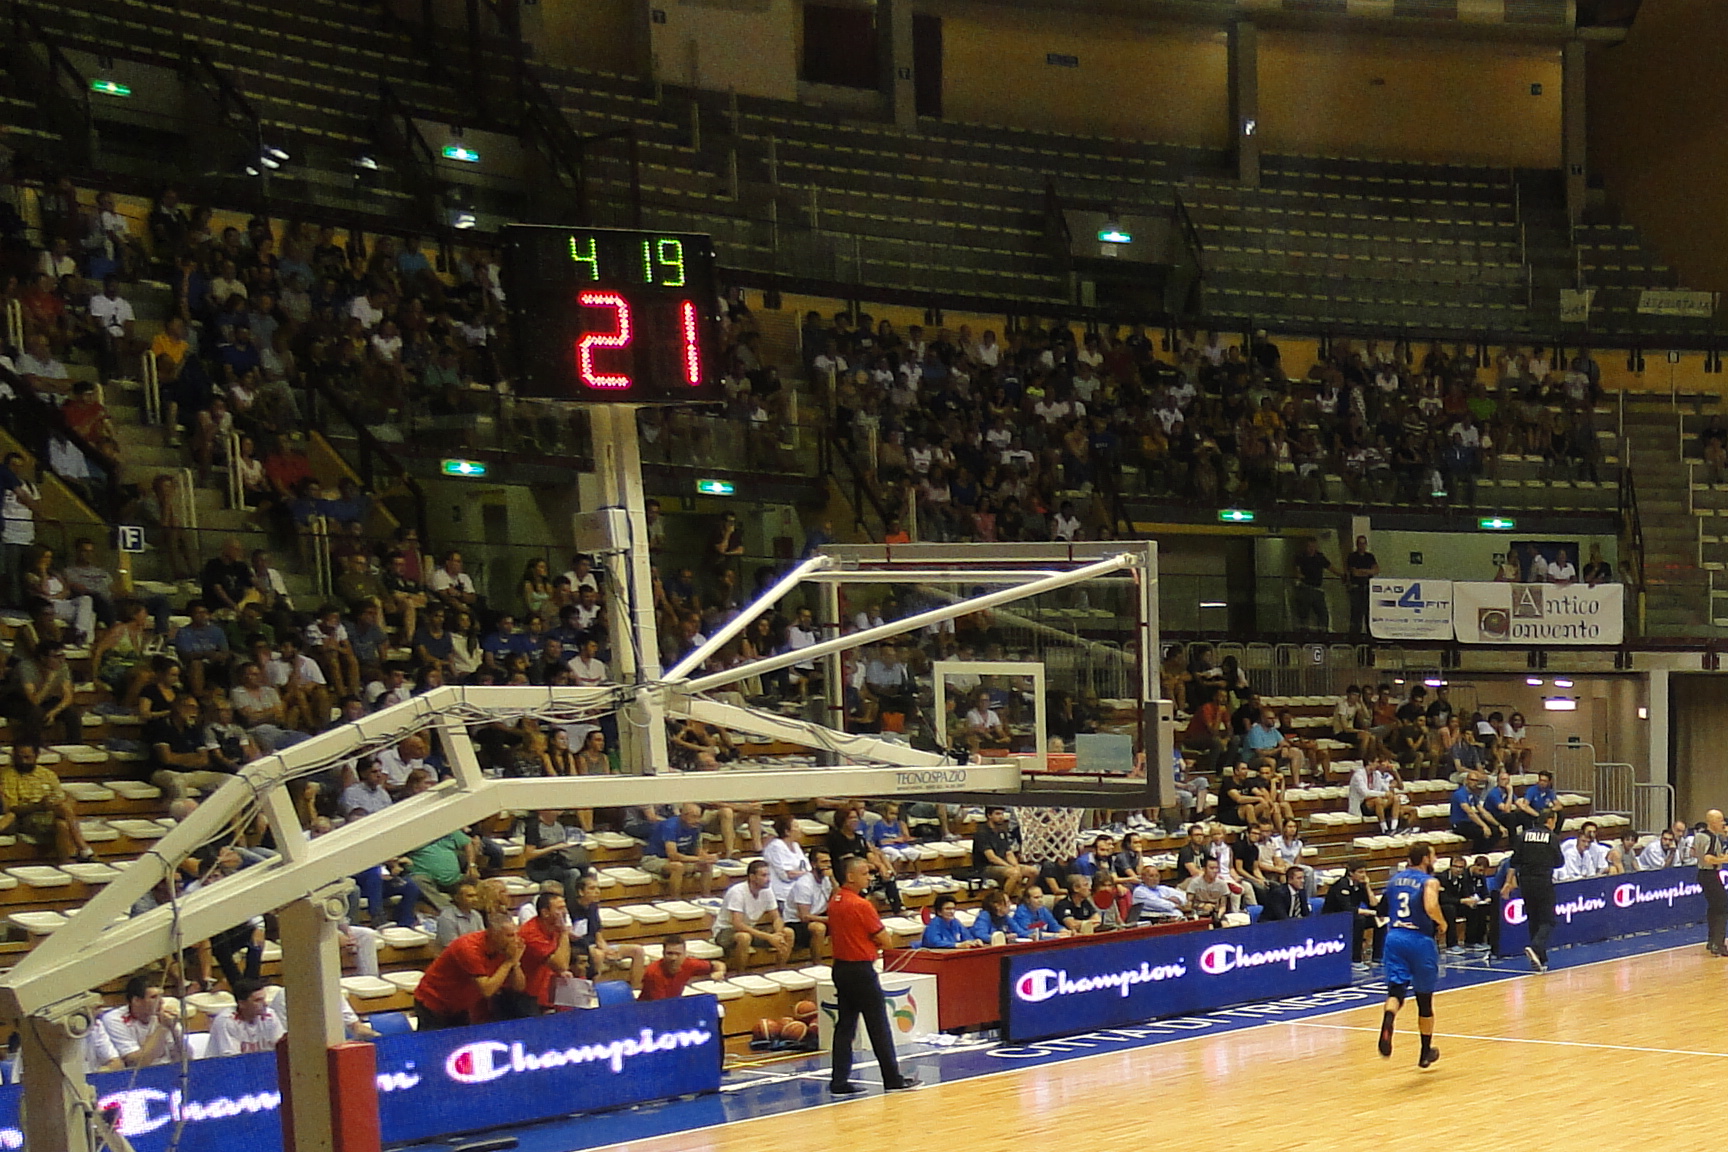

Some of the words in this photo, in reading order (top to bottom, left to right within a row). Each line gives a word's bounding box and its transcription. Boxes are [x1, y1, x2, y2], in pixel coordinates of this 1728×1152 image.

[569, 236, 599, 281] 4
[642, 238, 686, 287] 19
[577, 290, 701, 389] 21
[1398, 583, 1425, 613] 4
[1426, 600, 1450, 610] FIT
[1513, 588, 1600, 617] Antico
[1480, 609, 1600, 640] Convento
[896, 769, 967, 785] TECNOSPAZIO
[1524, 831, 1551, 844] ITALIA
[1397, 892, 1411, 918] 3
[1504, 886, 1604, 925] Cmpion
[1613, 881, 1702, 908] Champion
[1200, 936, 1343, 975] Champion
[1015, 959, 1185, 1003] Champion
[445, 1024, 708, 1084] Champion
